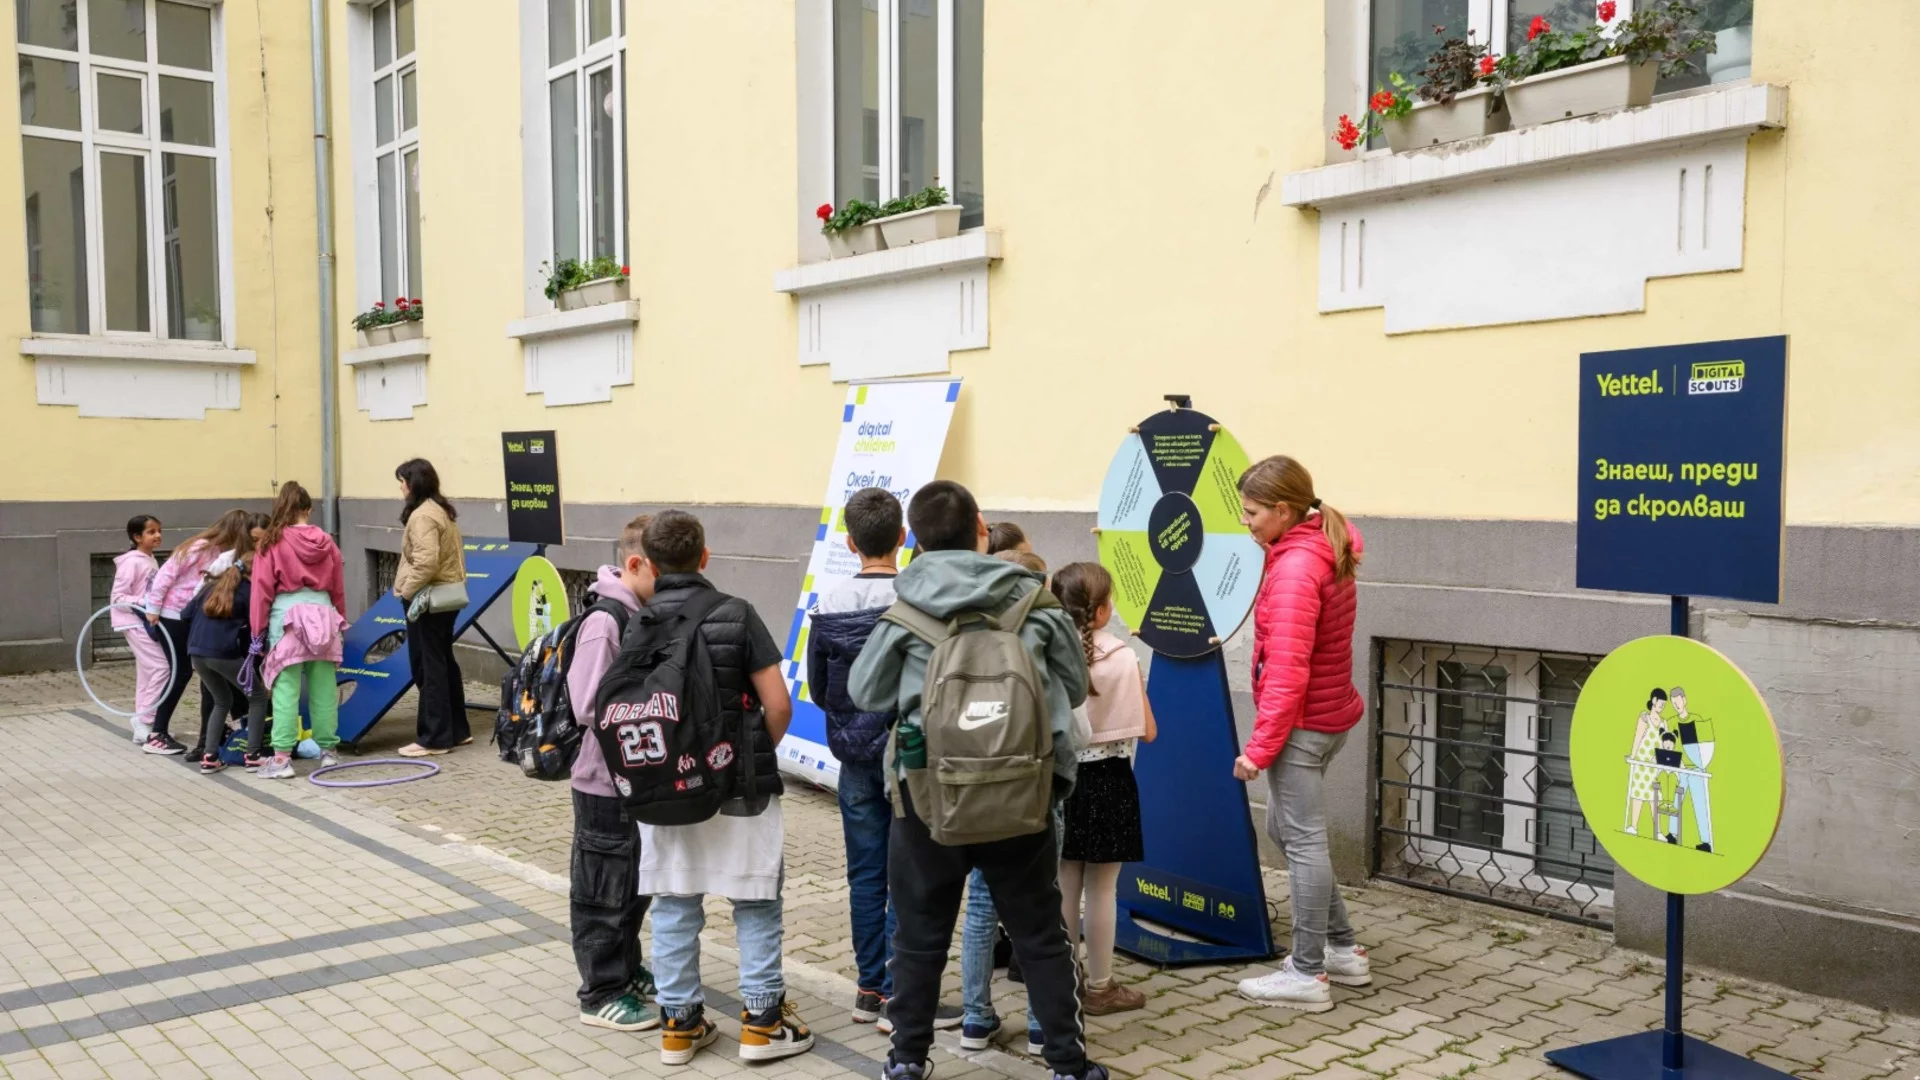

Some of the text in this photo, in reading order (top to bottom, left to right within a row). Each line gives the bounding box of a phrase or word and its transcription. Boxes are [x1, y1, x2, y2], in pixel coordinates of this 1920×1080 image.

[1696, 366, 1743, 380] DIGITAL
[1596, 369, 1664, 397] Yettel.
[1690, 379, 1737, 393] SCOUTS
[858, 419, 893, 438] digital
[854, 437, 896, 453] children
[846, 469, 892, 488] Окей ли
[1595, 458, 1758, 487] Знаеш, преди
[510, 481, 555, 496] Знаеш, преди
[511, 499, 520, 511] да
[1595, 493, 1746, 522] да скролваш
[966, 701, 1005, 717] NIKE
[617, 720, 668, 768] 23
[1135, 877, 1171, 902] Yettel.
